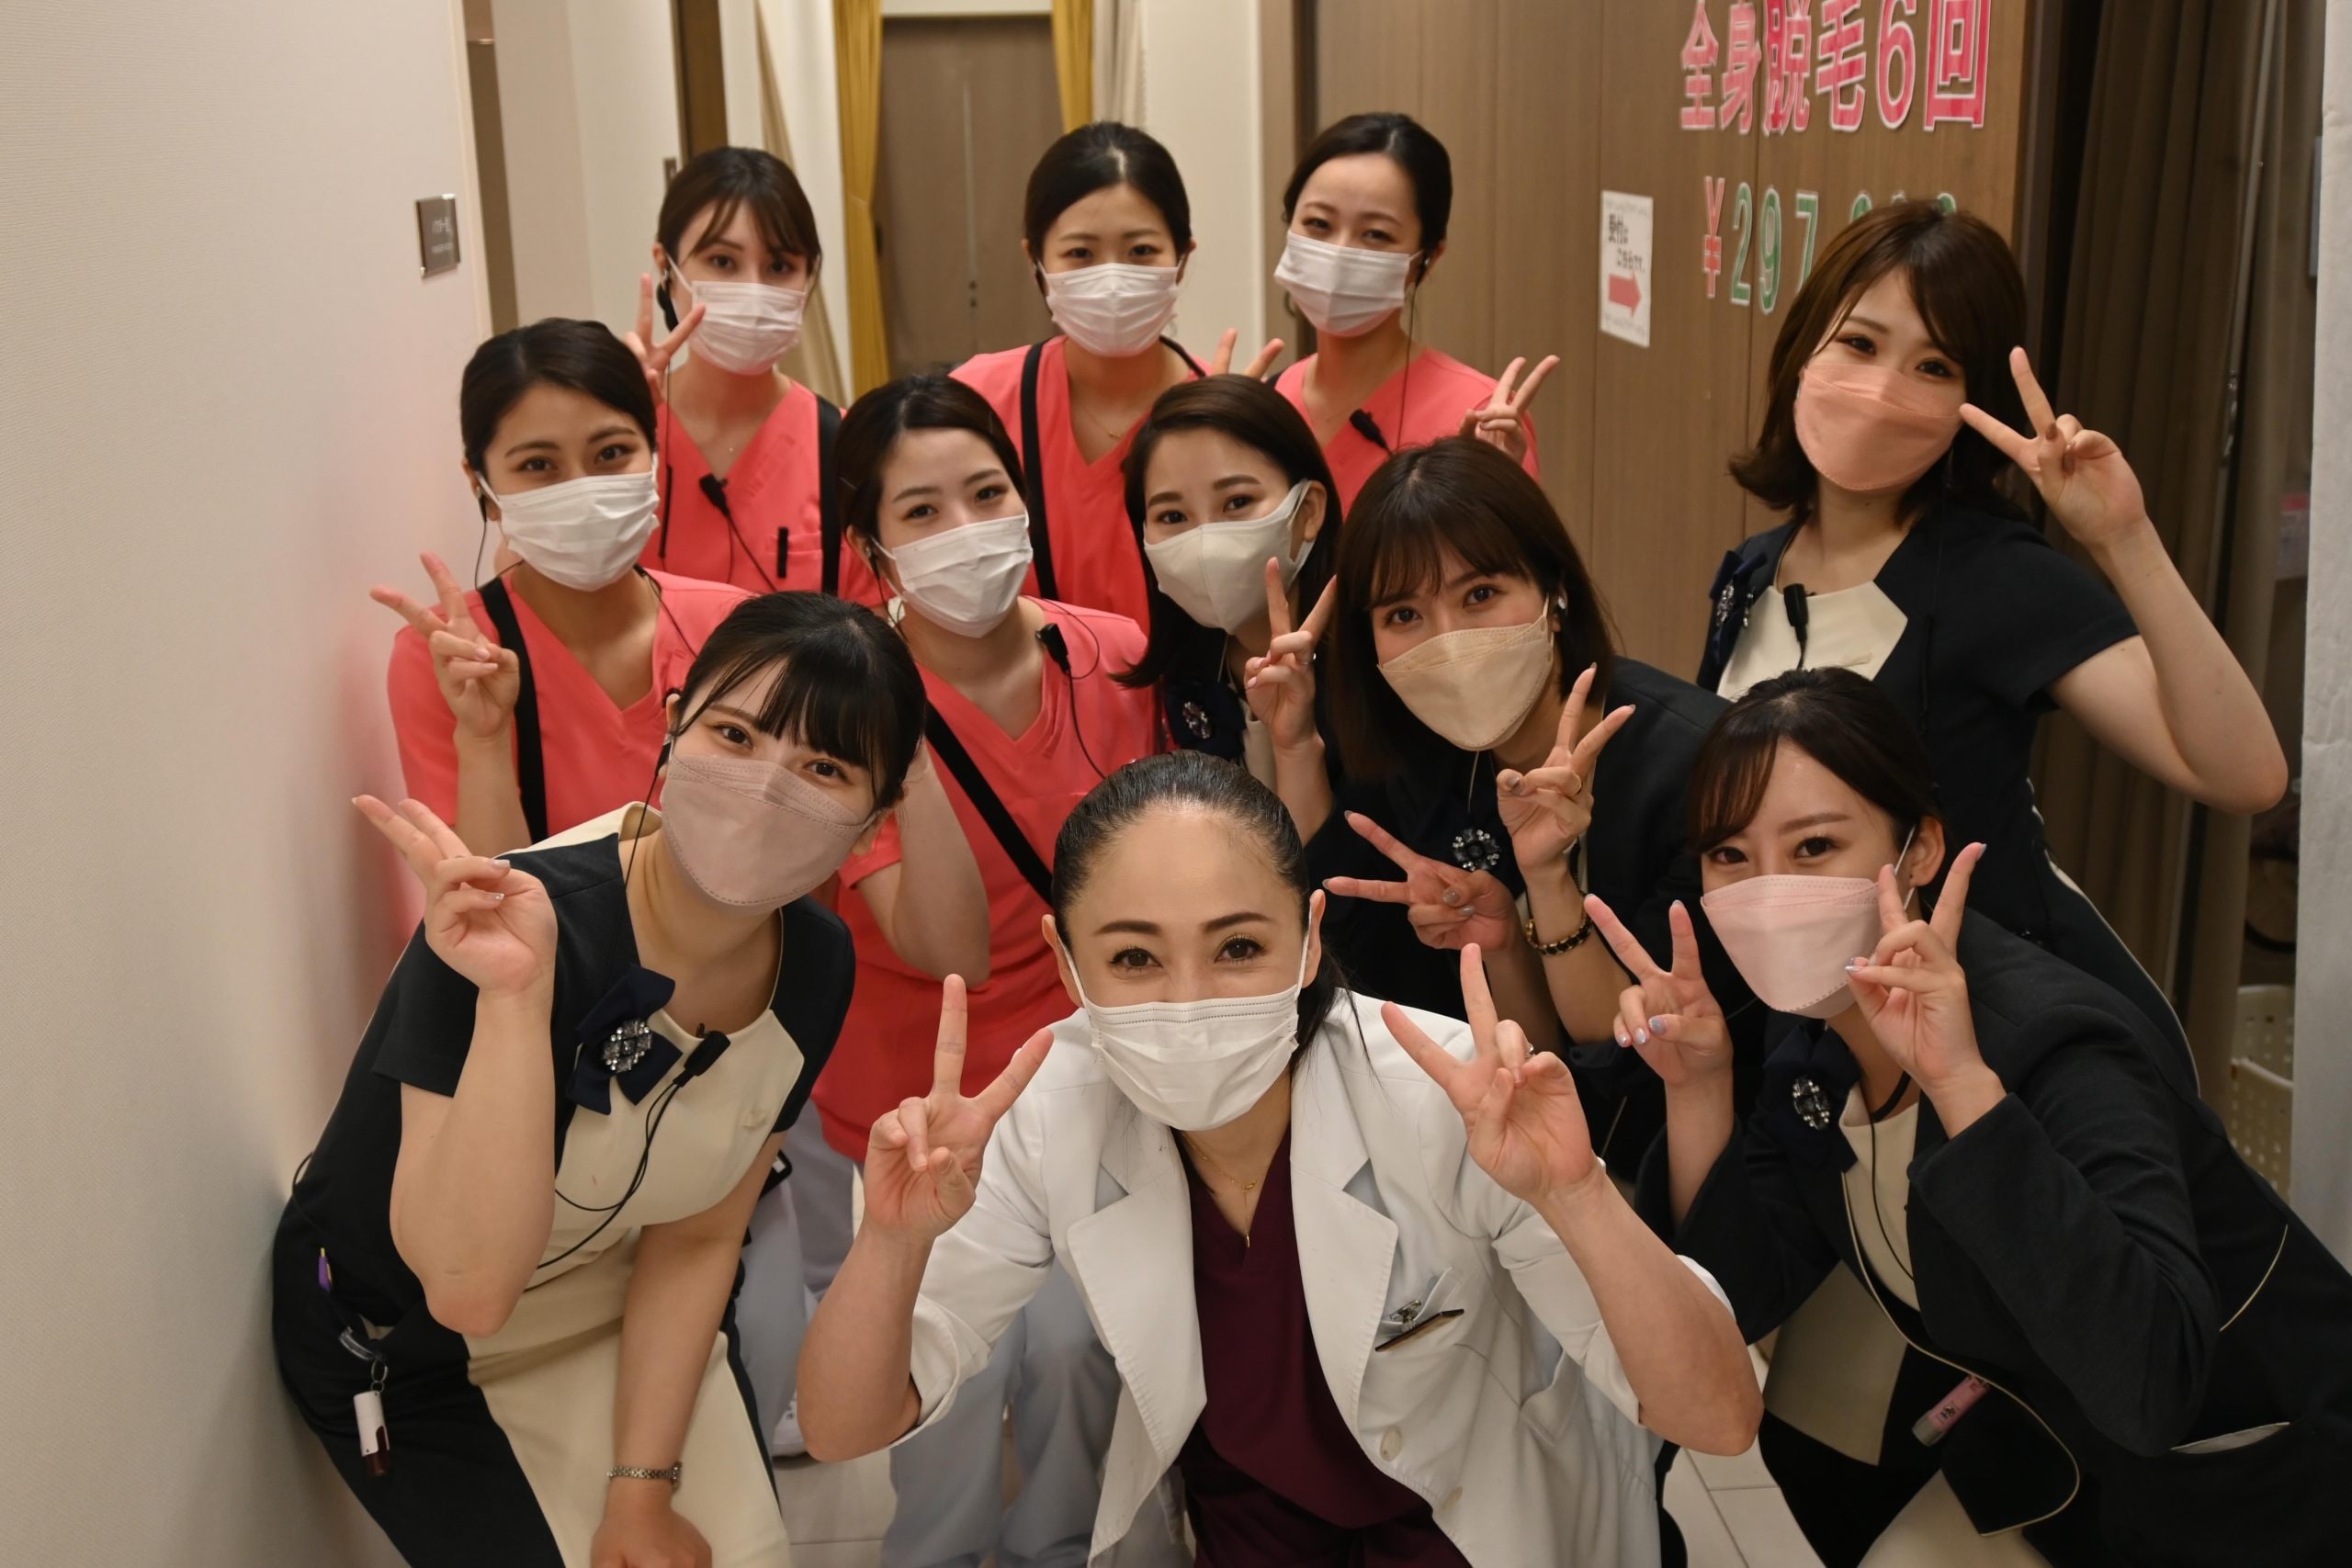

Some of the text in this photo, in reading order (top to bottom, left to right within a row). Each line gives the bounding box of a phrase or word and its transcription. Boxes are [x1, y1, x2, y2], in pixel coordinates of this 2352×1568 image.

[1680, 0, 1991, 137] 全身脱毛6回
[1702, 175, 1957, 314] ¥297
